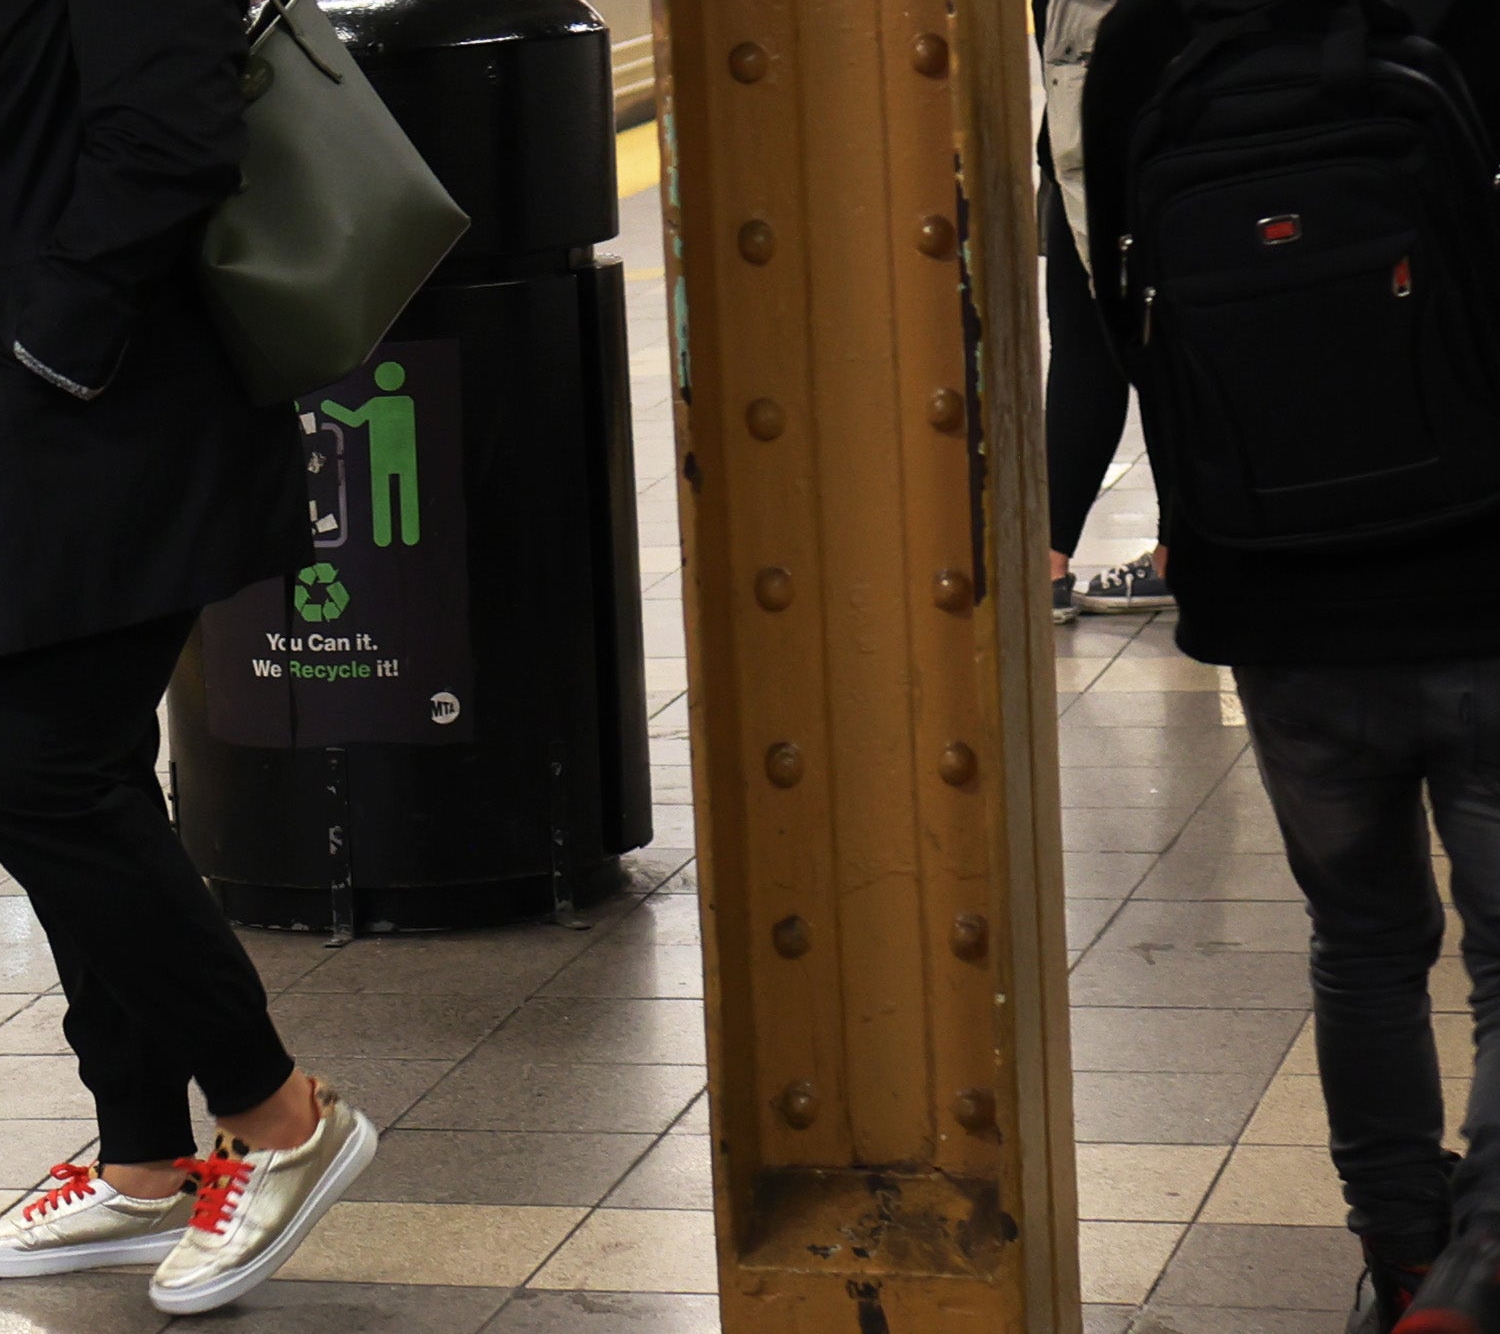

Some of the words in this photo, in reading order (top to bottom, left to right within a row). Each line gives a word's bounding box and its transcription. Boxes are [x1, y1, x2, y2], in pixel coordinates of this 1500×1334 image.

[308, 633, 350, 651] Can
[356, 633, 379, 651] it.
[252, 659, 282, 677] We
[376, 659, 399, 677] it!
